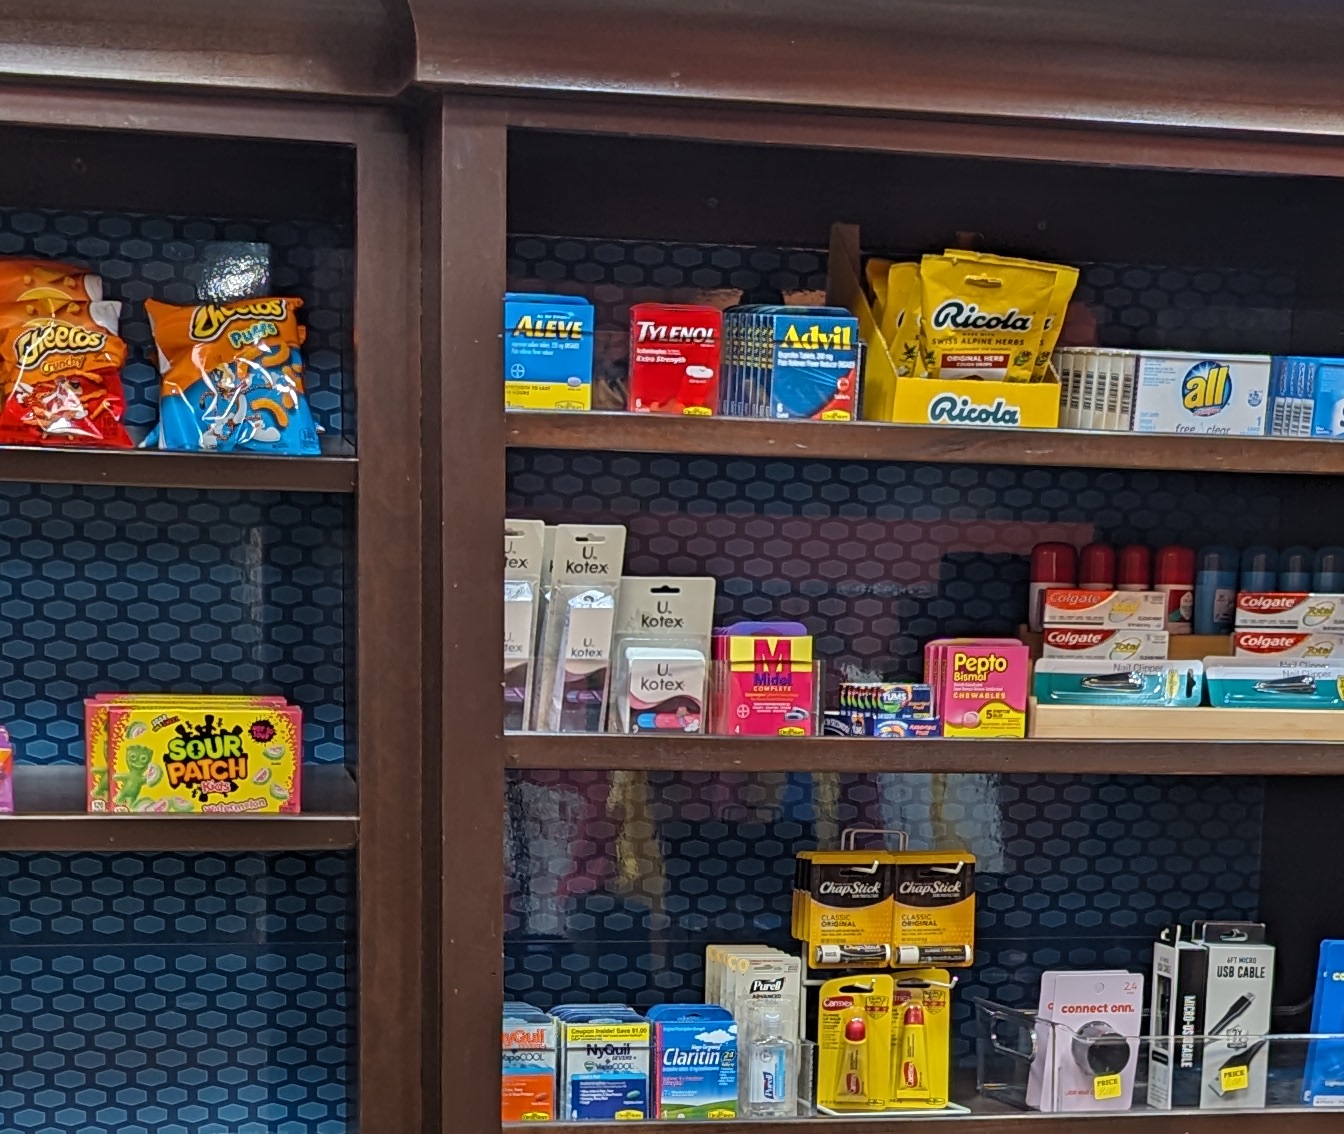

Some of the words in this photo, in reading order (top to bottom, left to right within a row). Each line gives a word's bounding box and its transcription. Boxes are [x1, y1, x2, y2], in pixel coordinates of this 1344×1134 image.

[933, 301, 1031, 332] Ricola
[513, 314, 584, 341] ALEVE
[636, 320, 717, 344] TYLENOL
[14, 324, 105, 364] Cheetos
[780, 324, 852, 351] Advil
[931, 338, 958, 346] SWISS
[961, 337, 993, 346] ALPINE
[996, 338, 1025, 347] HERBS
[42, 355, 86, 375] Crunchy
[946, 355, 982, 363] ORIGINAL
[983, 355, 1004, 363] HERB
[1183, 366, 1230, 410] all
[930, 395, 1020, 425] Ricola
[1175, 423, 1196, 433] free
[565, 560, 608, 574] kotex
[1049, 591, 1102, 606] Colgate
[1239, 594, 1296, 611] Colgate
[641, 613, 684, 629] kotex
[1047, 630, 1105, 647] Colgate
[1239, 634, 1296, 650] Colgate
[570, 646, 603, 658] kotex
[753, 638, 792, 673] M
[954, 653, 1008, 675] Pepto
[1113, 663, 1130, 672] Nail
[1131, 663, 1165, 675] Clipper
[954, 670, 987, 682] Bismol
[1300, 670, 1332, 680] Clipper
[640, 675, 685, 691] kotex
[883, 692, 907, 702] TUMS
[953, 691, 1006, 700] CHEWABLES
[986, 709, 993, 719] 5
[168, 735, 243, 761] SOUR
[166, 757, 247, 786] PATCH
[201, 781, 232, 794] Kids
[819, 881, 882, 896] ChapStick
[899, 881, 962, 896] ChapStick
[821, 920, 857, 928] ORIGINAL
[1239, 956, 1257, 964] MICRO
[1217, 965, 1235, 978] USB
[1238, 966, 1266, 979] CABLE
[752, 979, 784, 992] Purell
[1124, 981, 1138, 992] 2.4
[822, 998, 854, 1009] Carmex
[1061, 1003, 1109, 1014] connect
[1110, 1003, 1135, 1014] onn.
[570, 1028, 595, 1036] Coupon
[587, 1043, 632, 1060] NyQuil
[663, 1047, 720, 1067] Claritin
[595, 1062, 634, 1072] VapoCOOL
[1223, 1070, 1245, 1079] PRICE
[763, 1072, 774, 1100] Purell
[1096, 1078, 1119, 1088] PRICE
